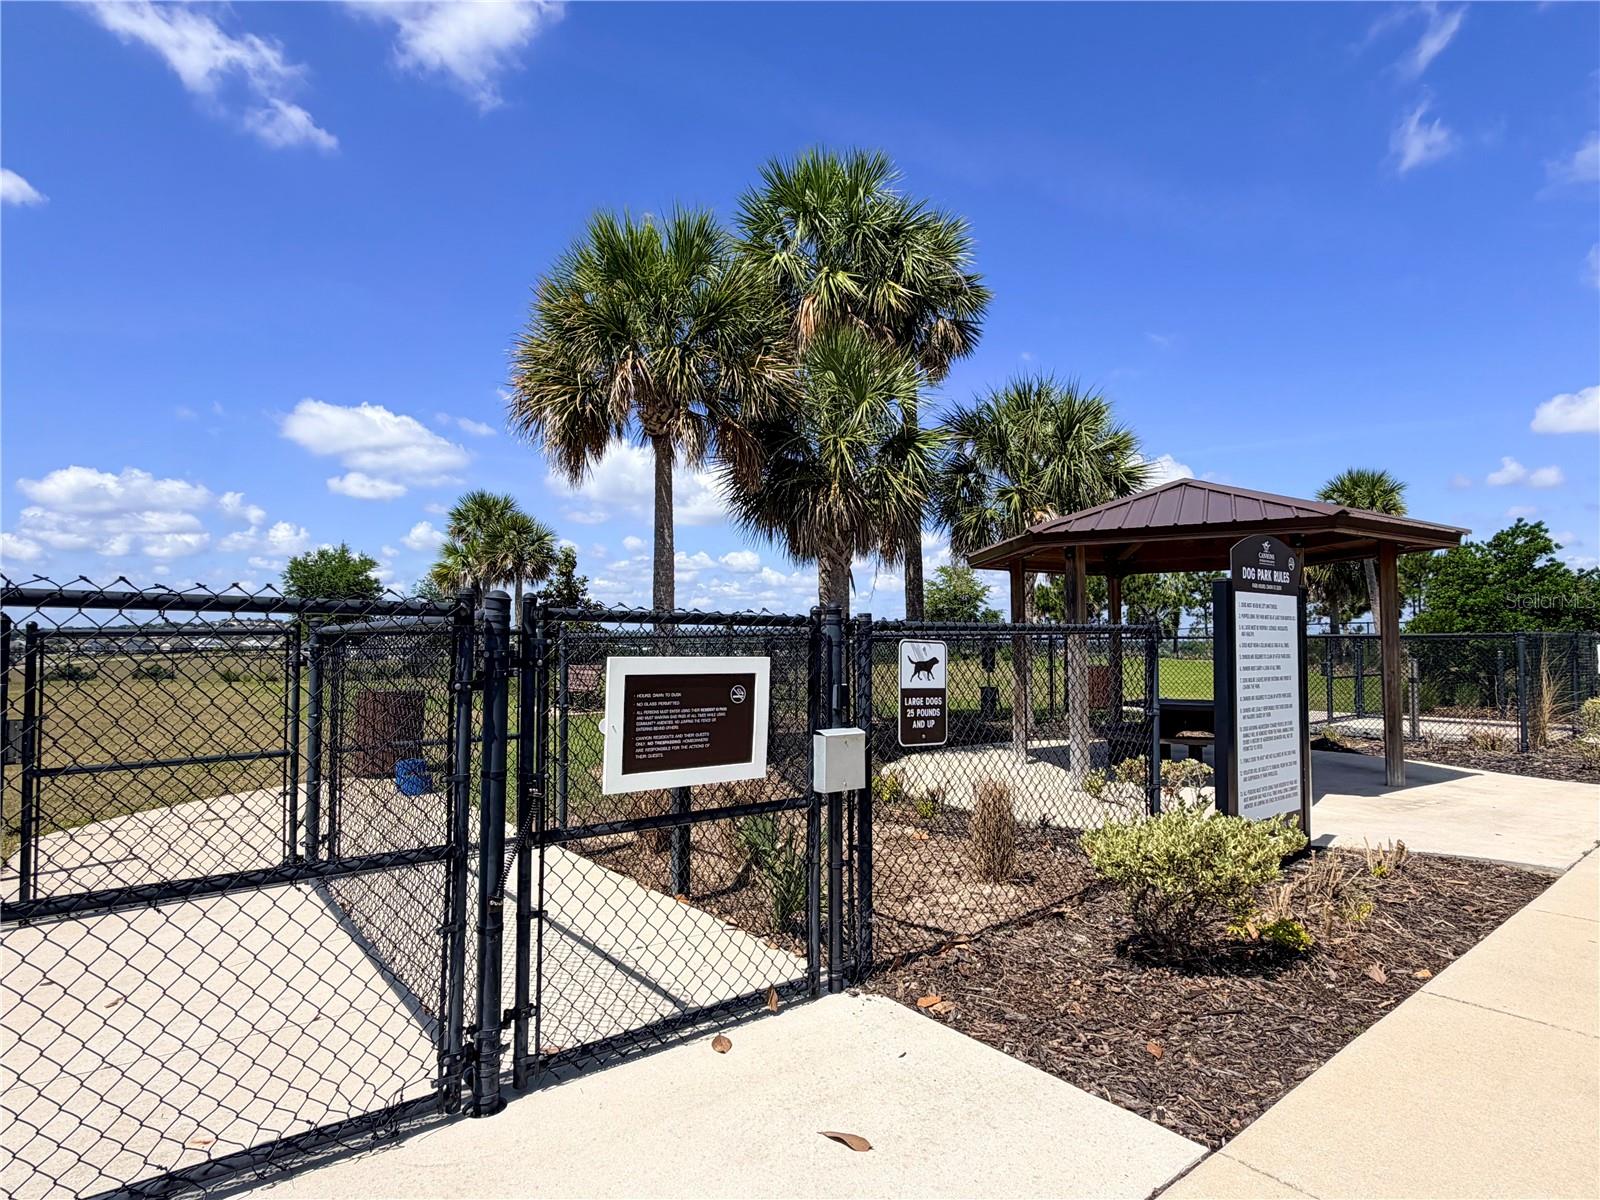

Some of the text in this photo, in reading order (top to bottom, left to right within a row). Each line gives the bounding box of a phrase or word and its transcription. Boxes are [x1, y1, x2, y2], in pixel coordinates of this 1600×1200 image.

[1242, 566, 1290, 584] DOG PARK RULES
[904, 696, 943, 706] LARGE DOGS
[906, 708, 941, 718] 25 POUNDS
[912, 719, 936, 729] AND UP
